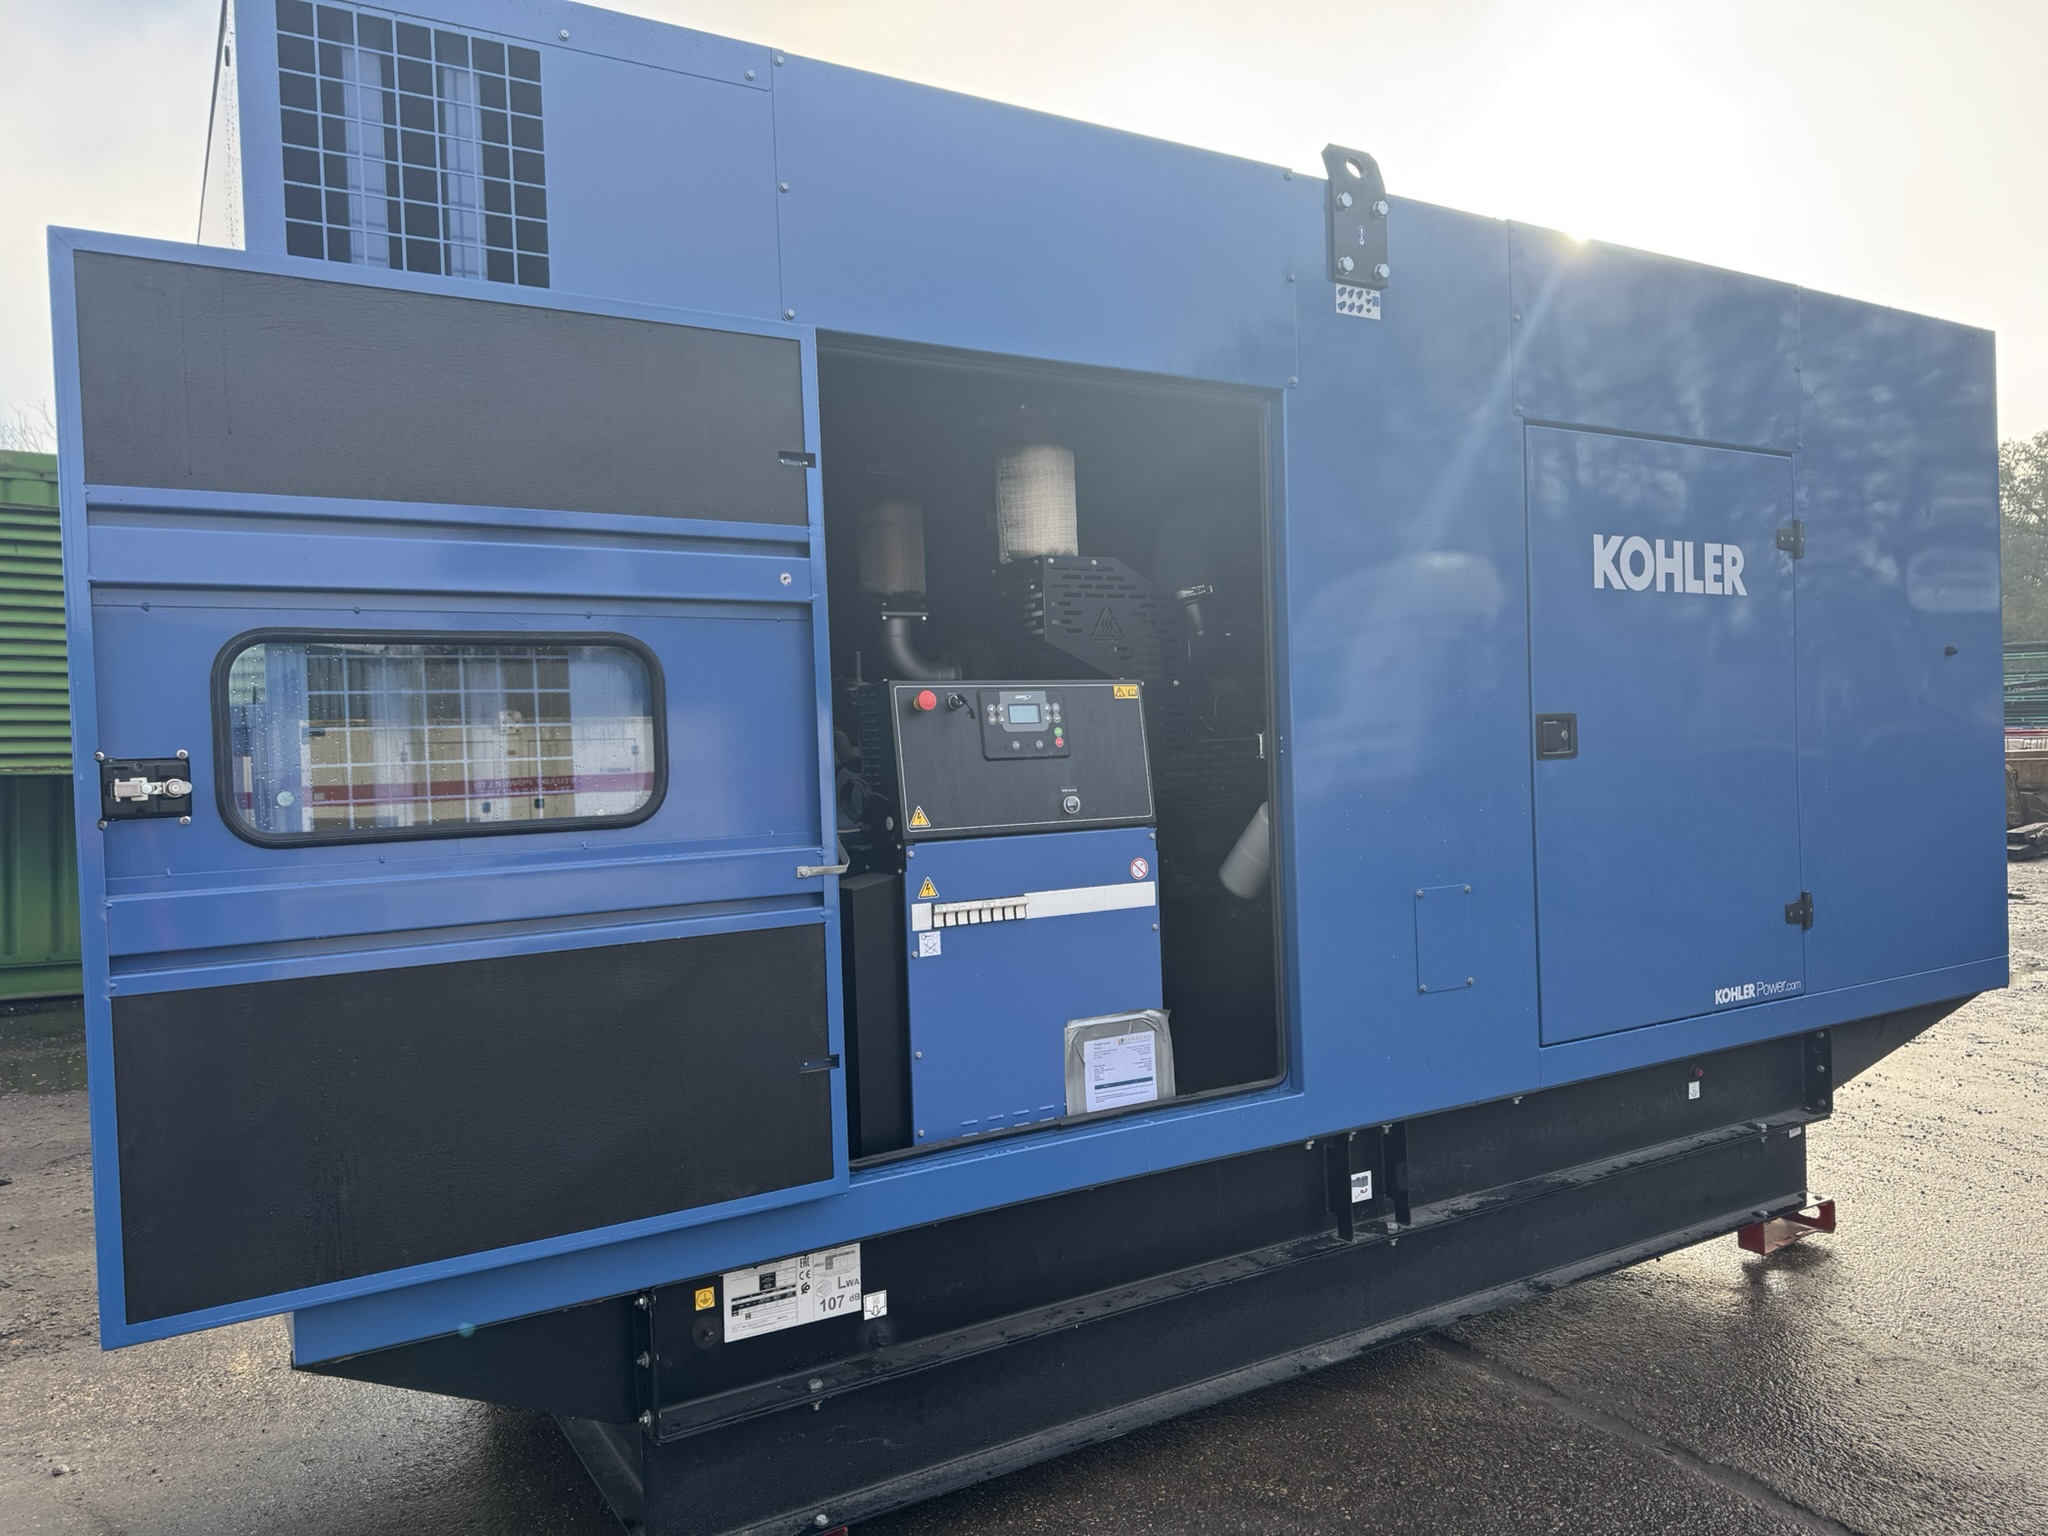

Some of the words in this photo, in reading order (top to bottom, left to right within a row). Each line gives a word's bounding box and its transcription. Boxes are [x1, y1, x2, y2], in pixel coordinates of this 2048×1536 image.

[1593, 534, 1748, 596] KOHLER
[1715, 983, 1756, 1005] KOHLER
[1757, 981, 1802, 996] Power.com
[799, 1269, 811, 1281] CE
[819, 1294, 845, 1313] 107
[849, 1292, 861, 1302] dB
